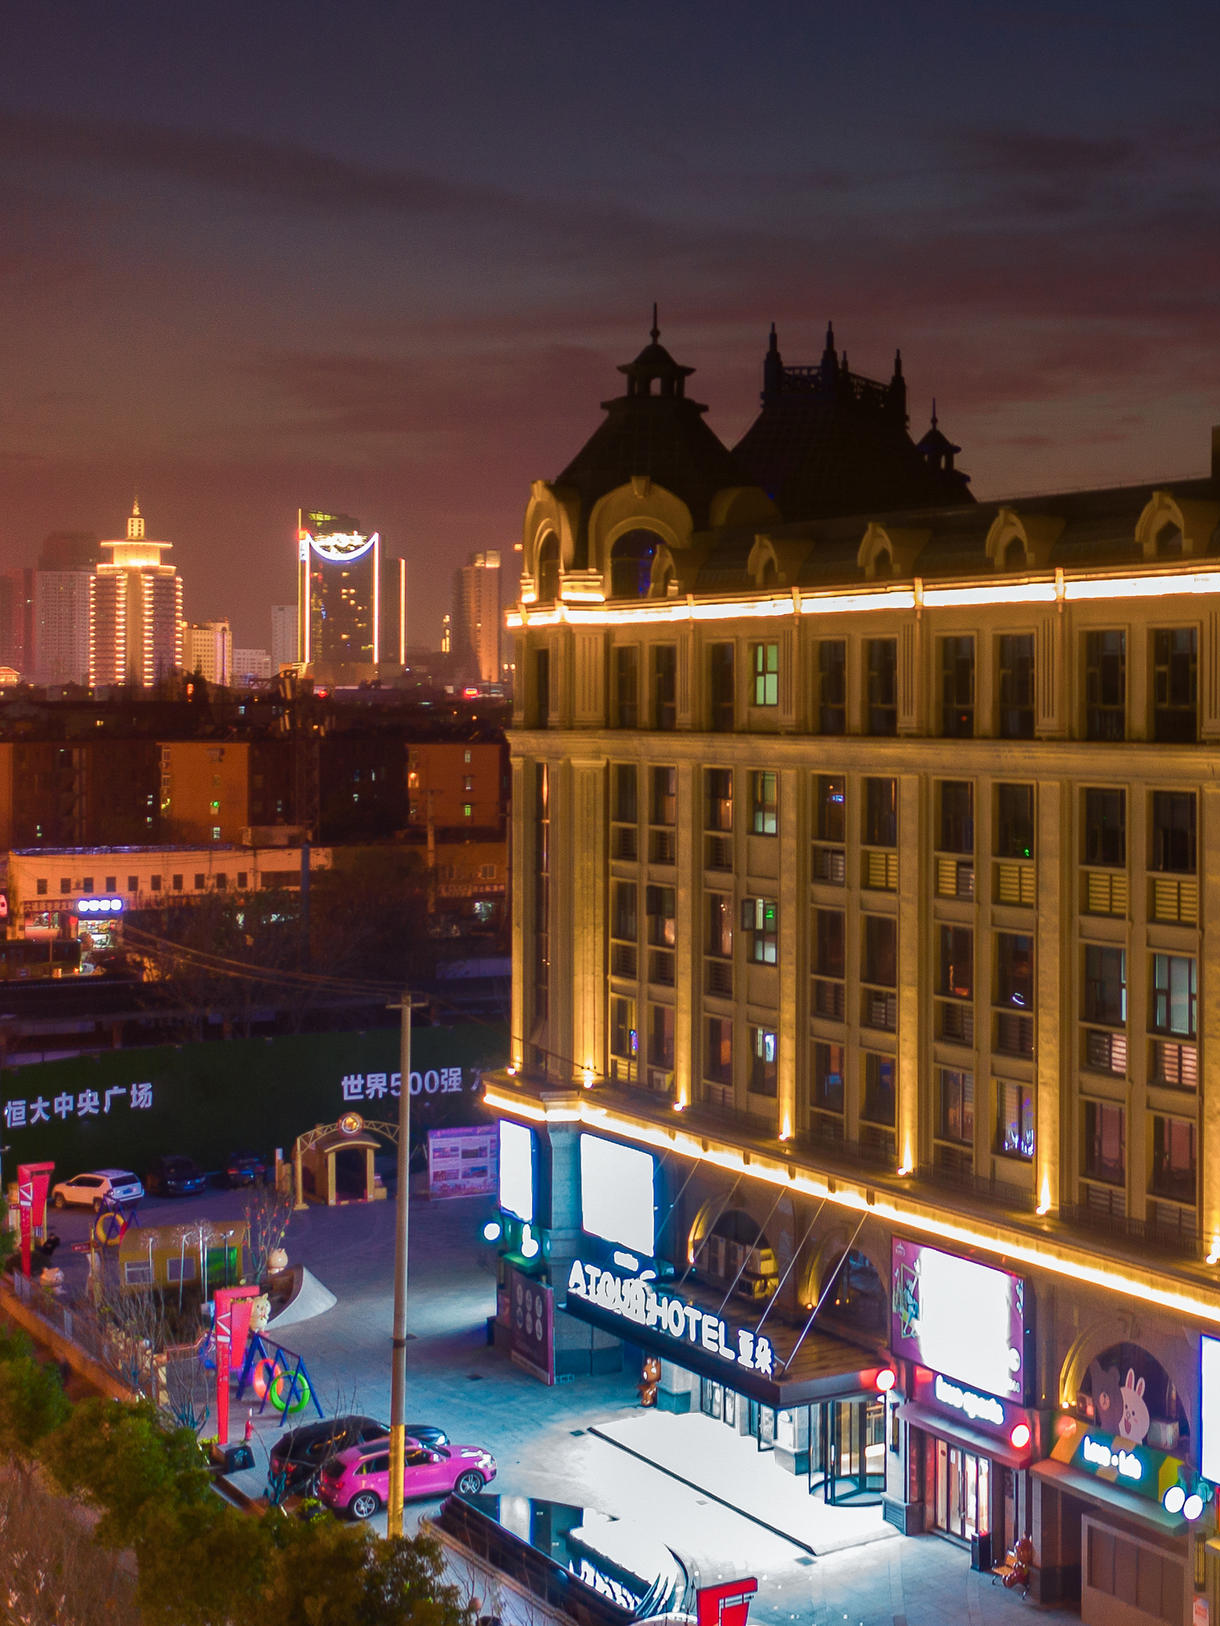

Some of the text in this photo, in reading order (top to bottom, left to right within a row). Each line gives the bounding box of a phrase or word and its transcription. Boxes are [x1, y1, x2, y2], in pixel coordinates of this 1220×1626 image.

[4, 1082, 153, 1128] 恒大中央广场
[647, 1291, 736, 1361] HOTEL
